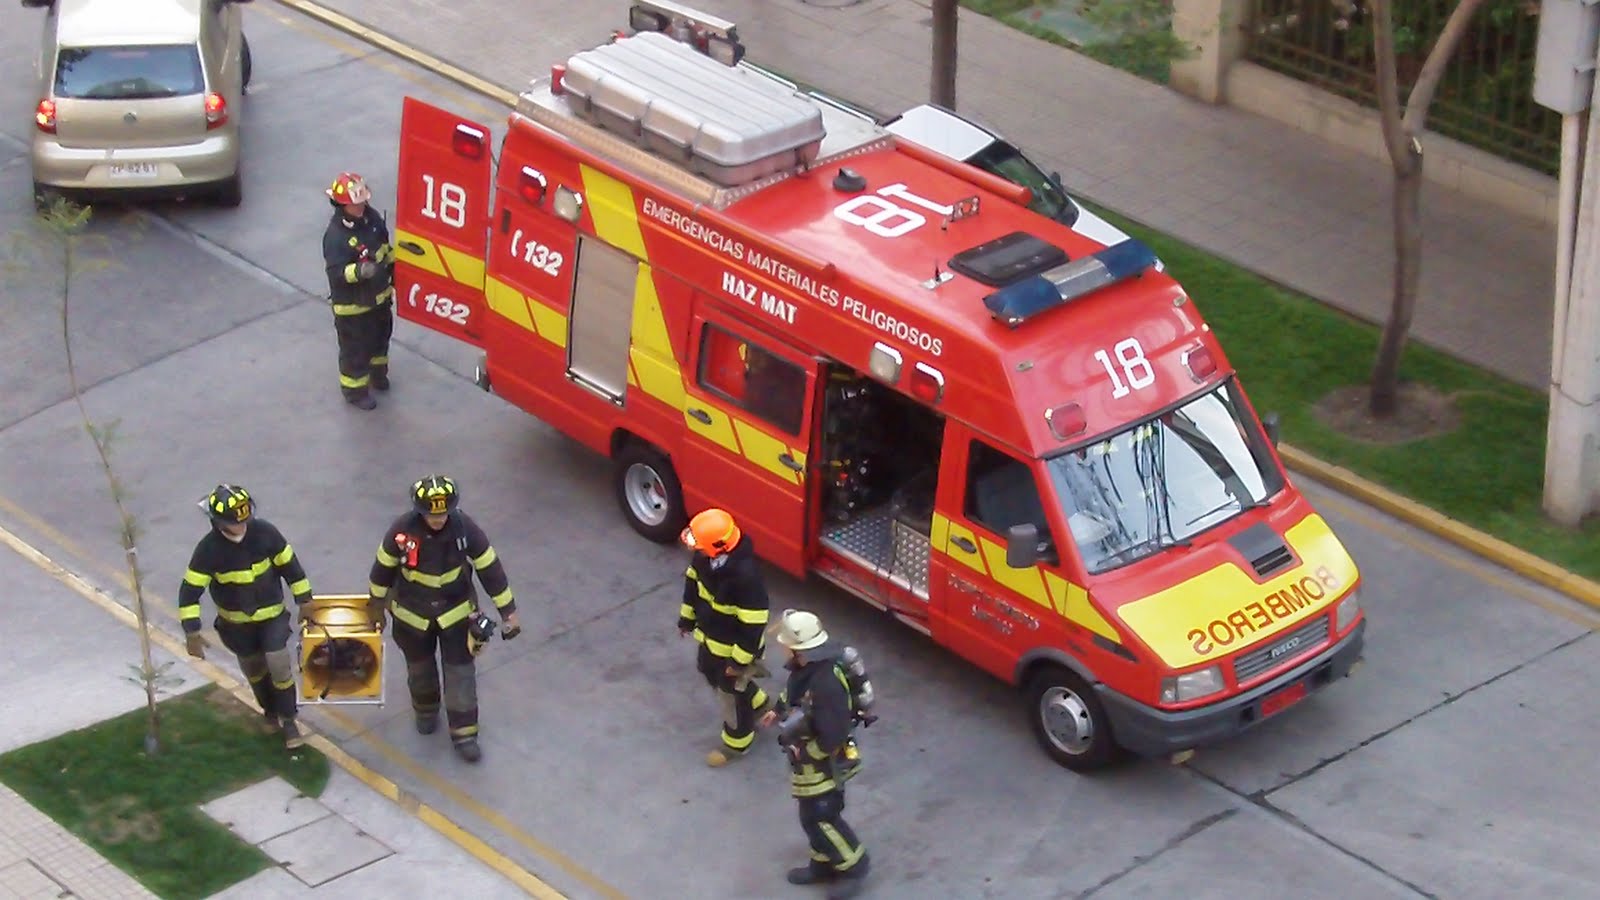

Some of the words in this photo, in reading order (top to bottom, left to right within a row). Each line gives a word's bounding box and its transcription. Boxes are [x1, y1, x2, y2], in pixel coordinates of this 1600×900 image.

[421, 174, 466, 228] 18
[834, 183, 954, 237] 18
[643, 198, 744, 259] EMERGENCIAS
[747, 249, 839, 308] MATERIALES
[843, 296, 943, 357] PELIGROSOS
[721, 271, 758, 306] HAZ
[761, 291, 798, 324] MAT
[1093, 338, 1155, 400] 18
